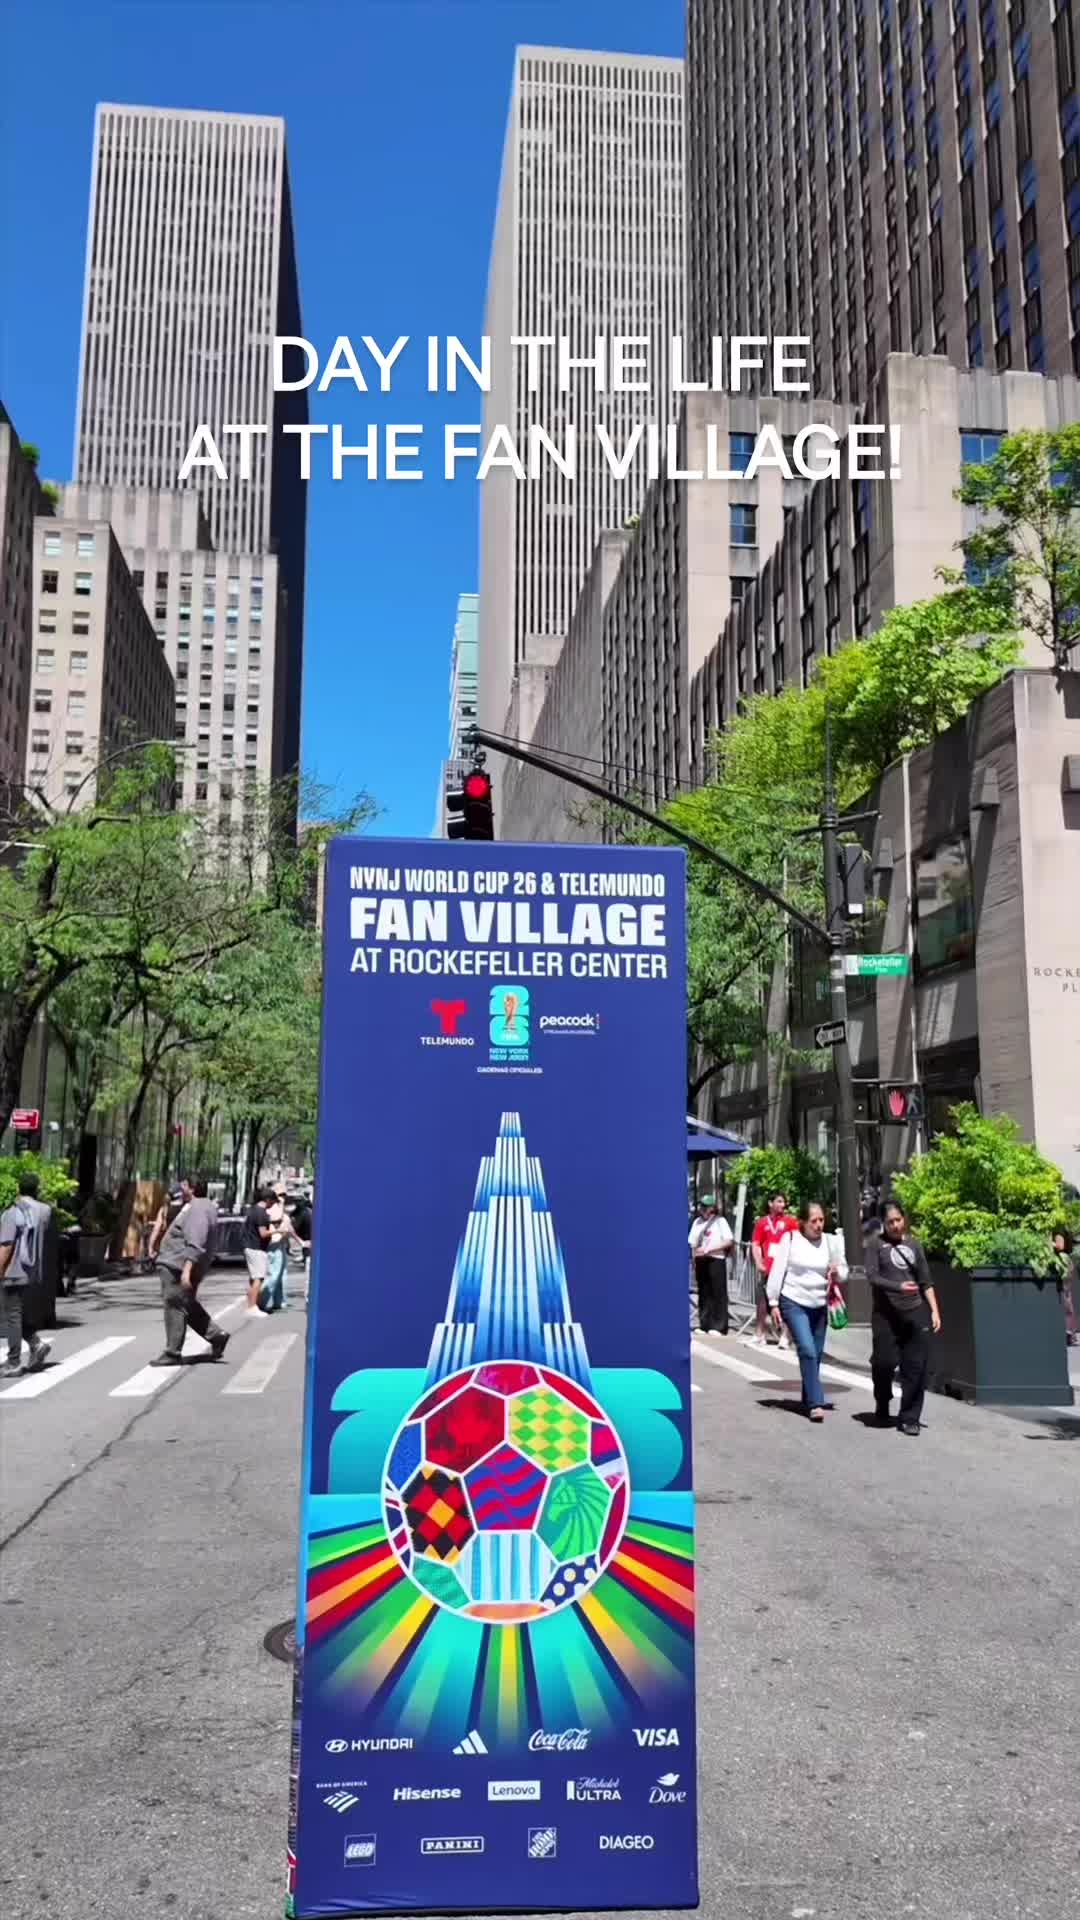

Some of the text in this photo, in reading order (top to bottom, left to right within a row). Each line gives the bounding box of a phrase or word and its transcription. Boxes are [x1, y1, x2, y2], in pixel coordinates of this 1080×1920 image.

[350, 866, 665, 898] NYNJ WORLD CUP 26 & TELEMUNDO
[350, 896, 667, 947] FAN VILLAGE
[350, 947, 668, 979] AT ROCKEFELLER CENTER
[539, 1013, 595, 1029] peacock
[420, 1036, 475, 1046] TELEMUNDO
[351, 1738, 414, 1751] HYUNDAI
[632, 1728, 680, 1747] VISA
[393, 1787, 462, 1801] Hisense
[492, 1785, 537, 1796] Lenovo
[576, 1790, 622, 1801] ULTRA
[648, 1786, 687, 1804] Dove
[426, 1840, 480, 1850] PANINI
[599, 1834, 655, 1850] DIAGEO
